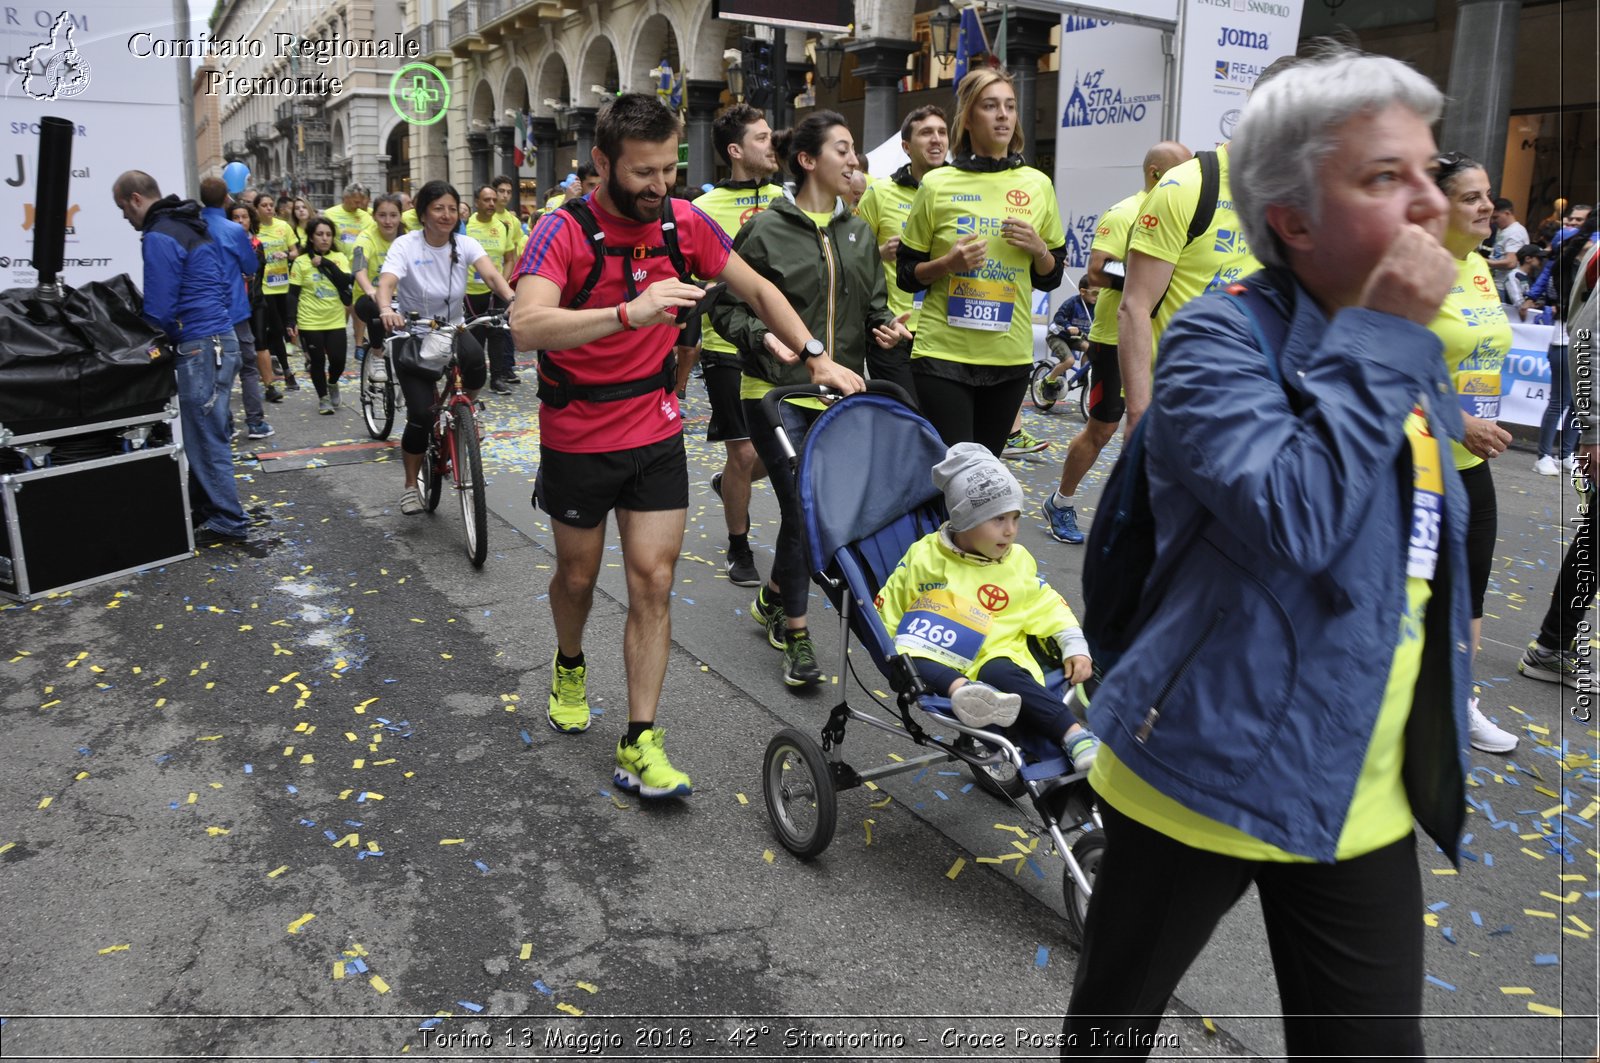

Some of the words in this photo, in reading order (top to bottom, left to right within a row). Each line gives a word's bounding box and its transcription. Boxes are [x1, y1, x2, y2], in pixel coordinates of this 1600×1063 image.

[1083, 69, 1106, 90] 42°
[1087, 88, 1123, 108] STRA
[1088, 103, 1147, 125] TORINO
[1005, 207, 1033, 216] TOYOTA
[976, 267, 1016, 282] TORINO
[963, 304, 1000, 321] 3081
[1506, 353, 1552, 377] TOY
[906, 617, 958, 648] 4269
